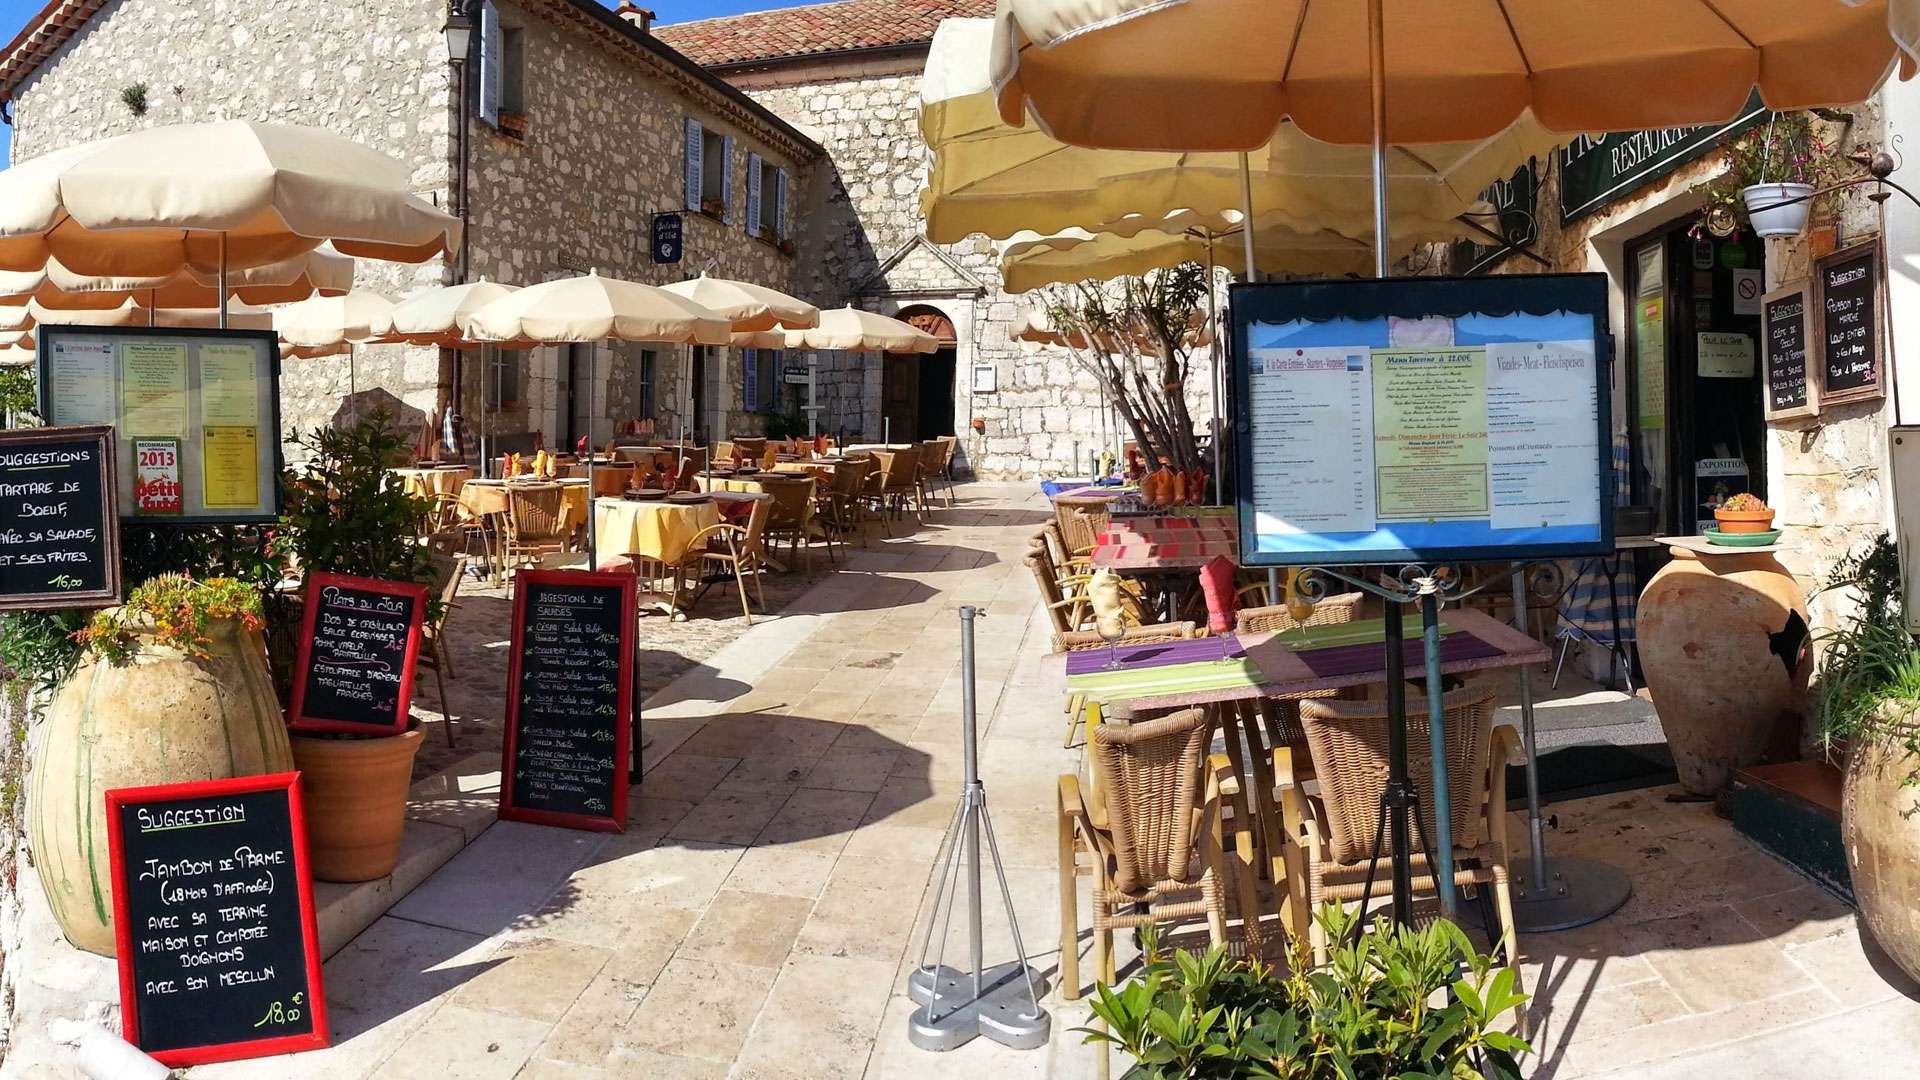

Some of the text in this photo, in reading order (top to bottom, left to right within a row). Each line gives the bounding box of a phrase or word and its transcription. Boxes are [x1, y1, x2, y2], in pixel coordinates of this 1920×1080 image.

[139, 451, 175, 467] 2013
[0, 481, 81, 498] TARTARE DE
[0, 528, 25, 545] AVEC
[25, 531, 44, 545] SA
[15, 553, 47, 566] SES
[48, 574, 83, 591] 16,00
[323, 586, 355, 608] PLATS
[376, 596, 404, 612] JOUR
[592, 595, 606, 605] DE
[323, 613, 342, 625] DOS
[347, 618, 358, 628] DE
[137, 803, 246, 829] SUGGESTION
[138, 845, 286, 882] JAMBON DE PARME
[148, 904, 269, 931] AVEC SA TERRINE
[141, 920, 269, 954] MAISON ET COMPOTÉE
[180, 946, 245, 968] D'OIGNONS
[146, 966, 276, 996] AVEC SON MESCLUN
